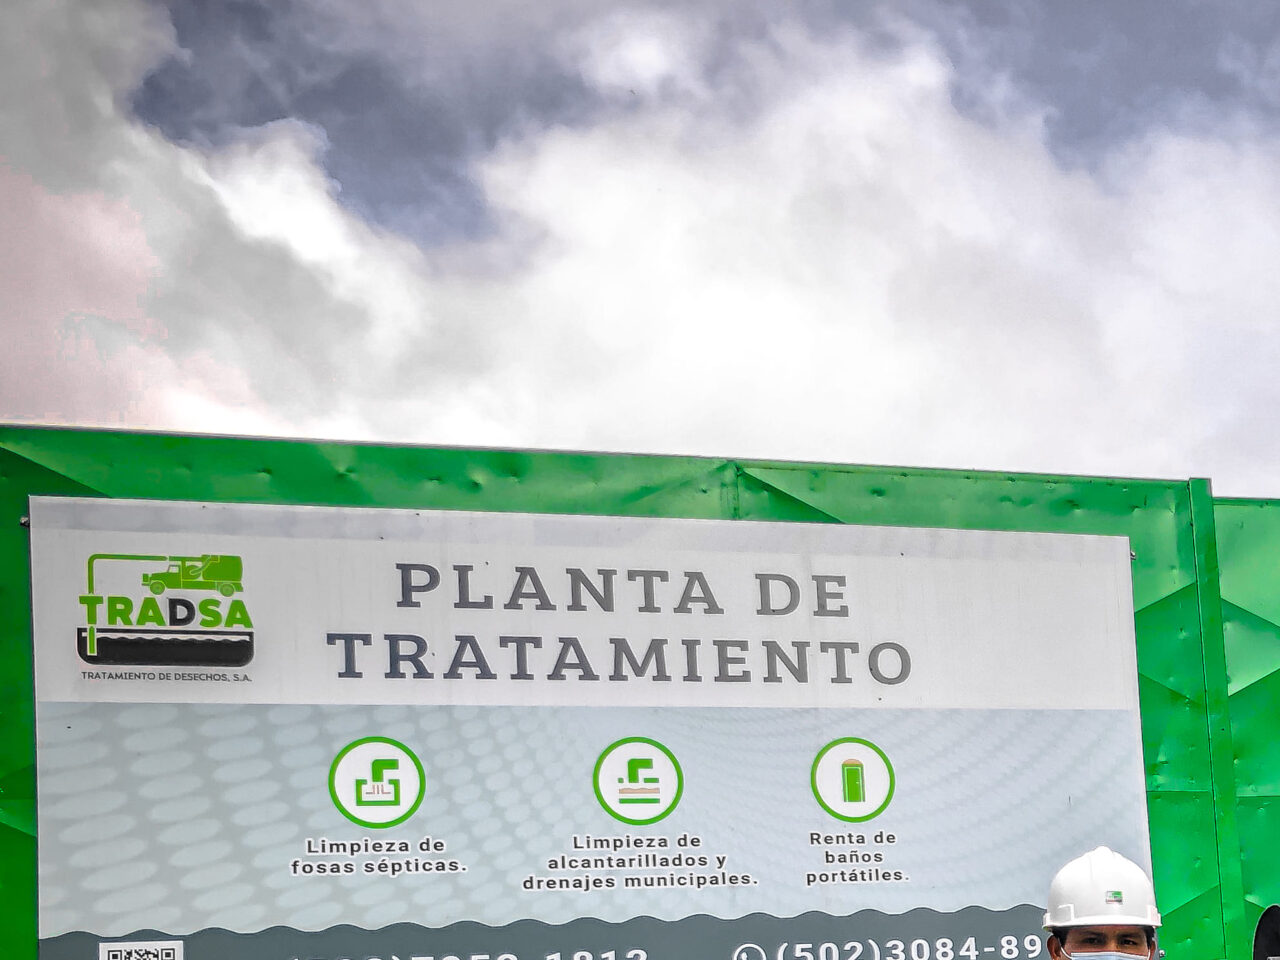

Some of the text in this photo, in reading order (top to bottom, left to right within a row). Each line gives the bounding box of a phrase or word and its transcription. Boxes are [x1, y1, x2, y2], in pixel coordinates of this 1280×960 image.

[395, 562, 849, 618] PLANTA DE
[78, 595, 254, 629] TRADSA
[326, 632, 912, 686] TRATAMIENTO
[81, 671, 252, 683] TRATAMIENTO DE DESECHOS, S.A.
[307, 838, 445, 856] Limpieza de
[573, 834, 701, 851] Limpieza de
[810, 831, 896, 845] Renta de
[548, 853, 726, 869] alcantarillados y
[825, 850, 883, 864] baños
[291, 858, 467, 876] fosas sépticas.
[523, 872, 759, 891] drenajes municipales.
[806, 868, 910, 886] portátiles.
